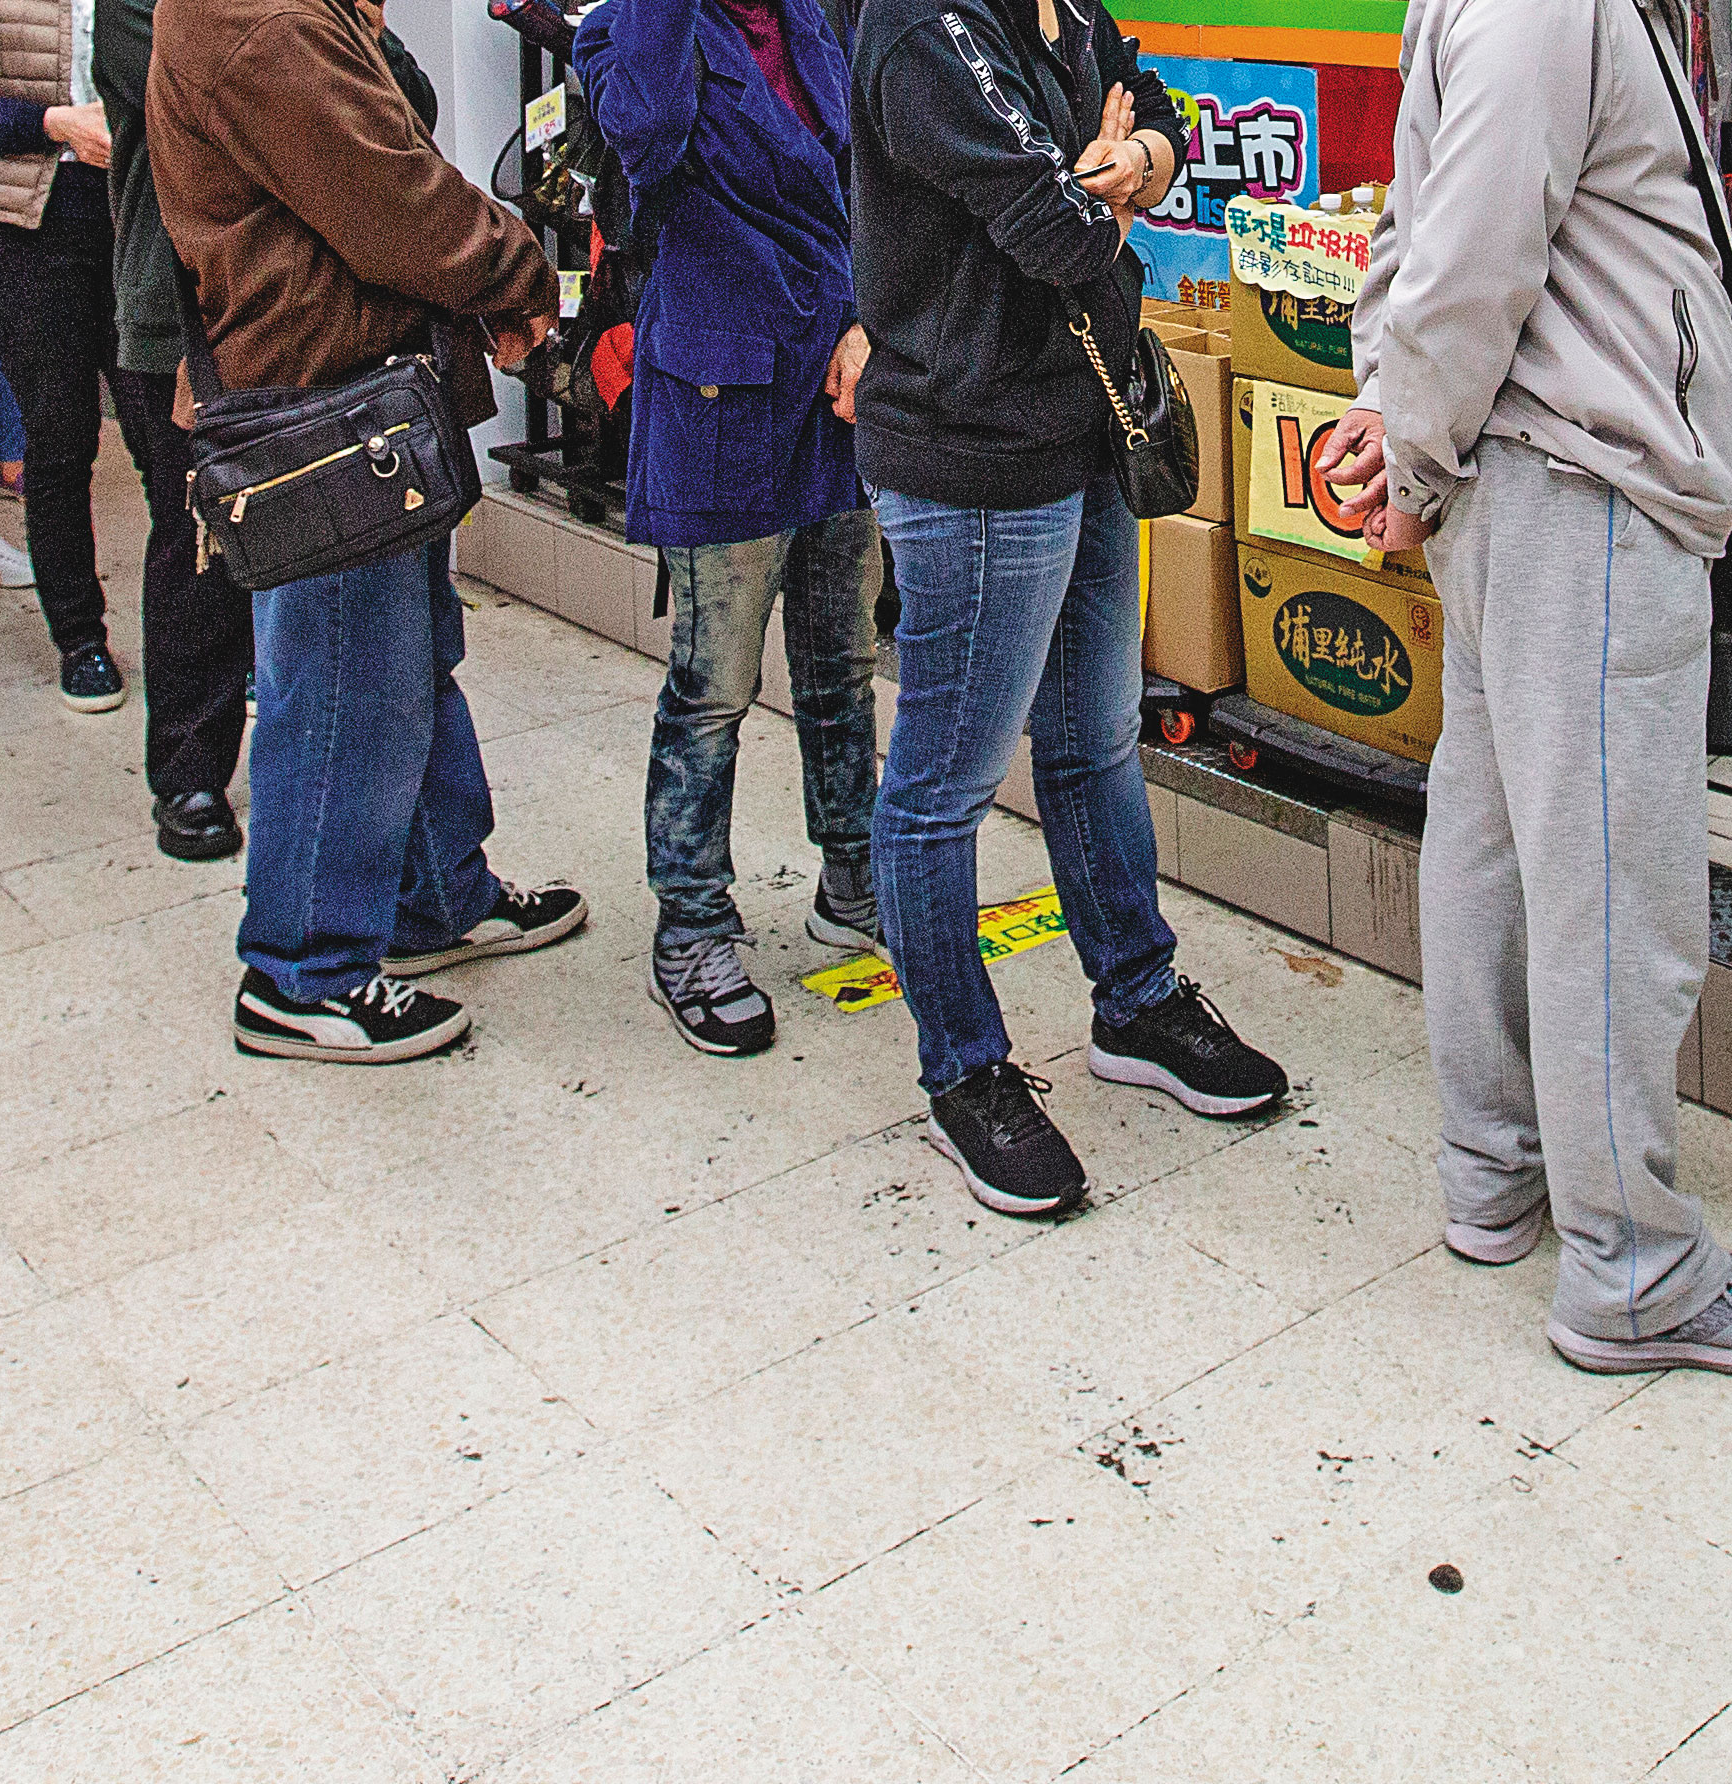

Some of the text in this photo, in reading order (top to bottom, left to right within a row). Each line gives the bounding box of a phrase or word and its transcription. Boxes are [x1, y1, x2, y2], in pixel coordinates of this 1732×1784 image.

[971, 58, 994, 94] NIKE
[1279, 604, 1409, 696] 埔里純水
